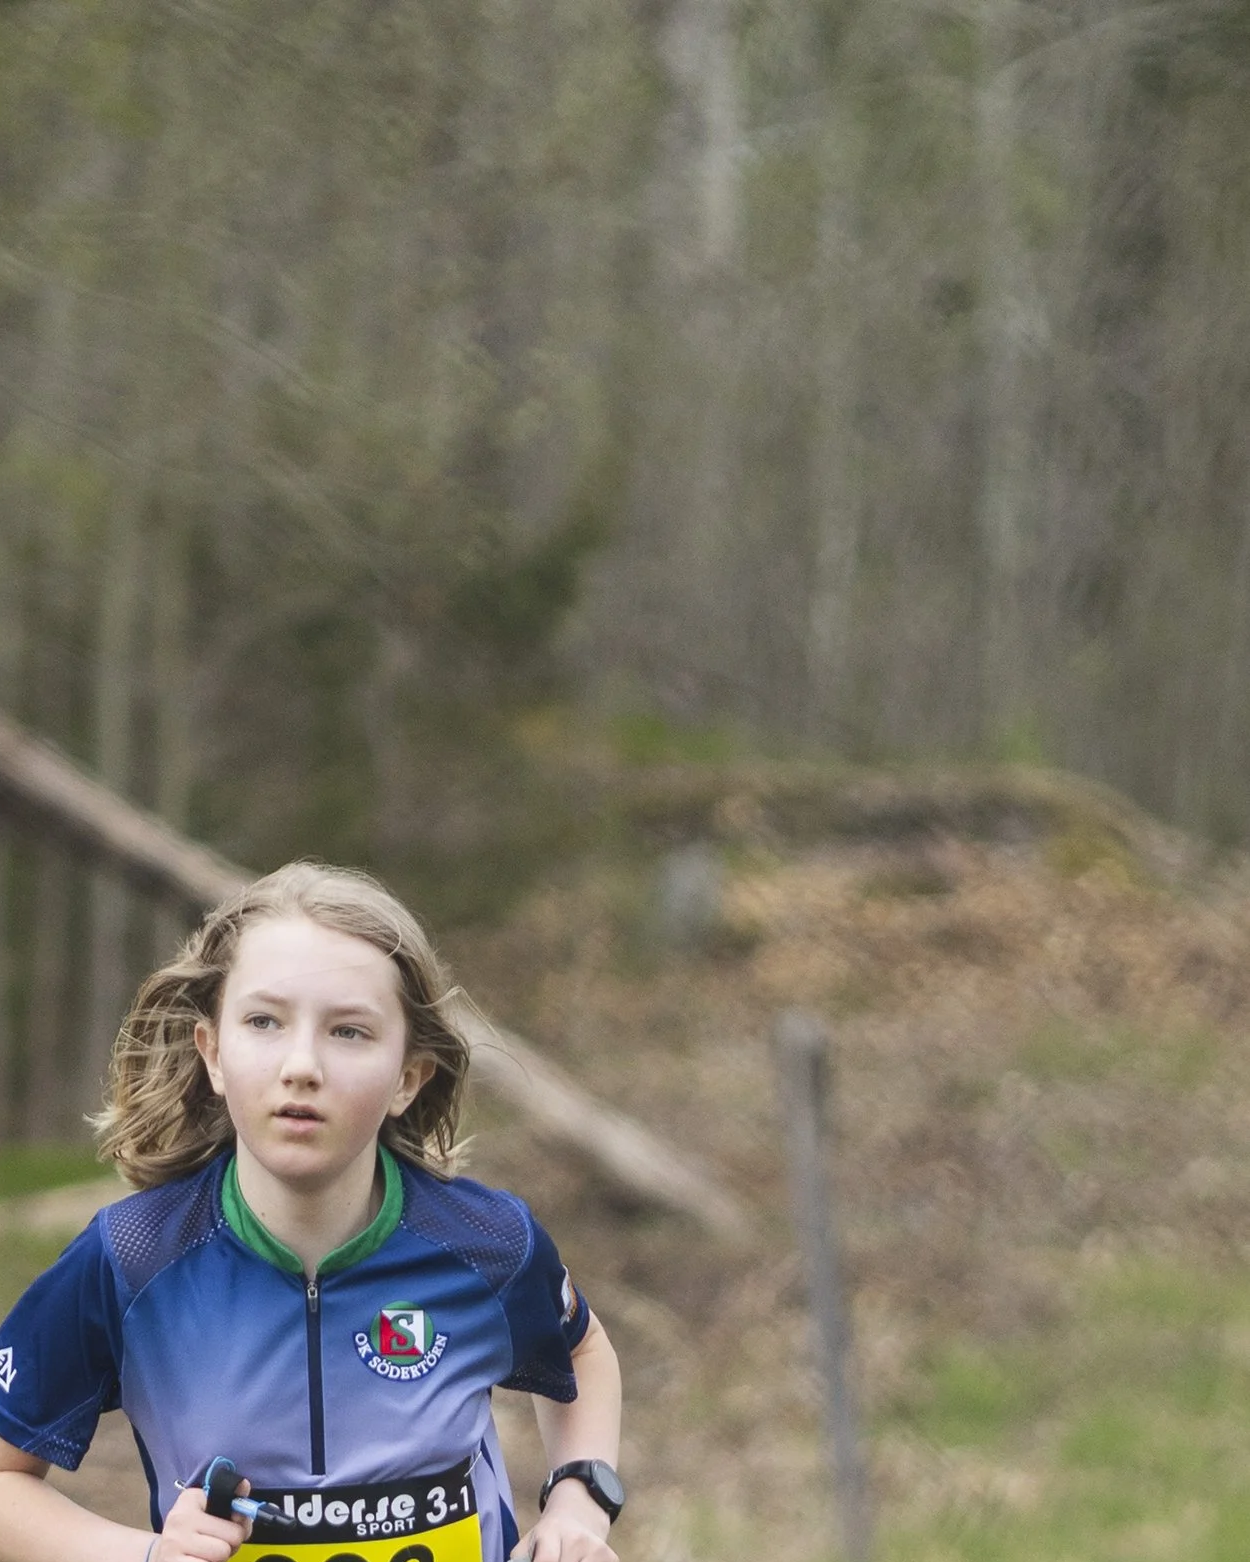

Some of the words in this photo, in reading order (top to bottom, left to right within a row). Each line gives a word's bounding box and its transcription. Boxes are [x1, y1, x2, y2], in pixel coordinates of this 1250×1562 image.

[391, 1313, 416, 1351] S
[355, 1332, 373, 1358] OK
[368, 1333, 448, 1380] SÖDERTÖRN
[269, 1494, 416, 1527] lder.se
[425, 1485, 470, 1524] 3-1
[356, 1517, 416, 1536] SPORT
